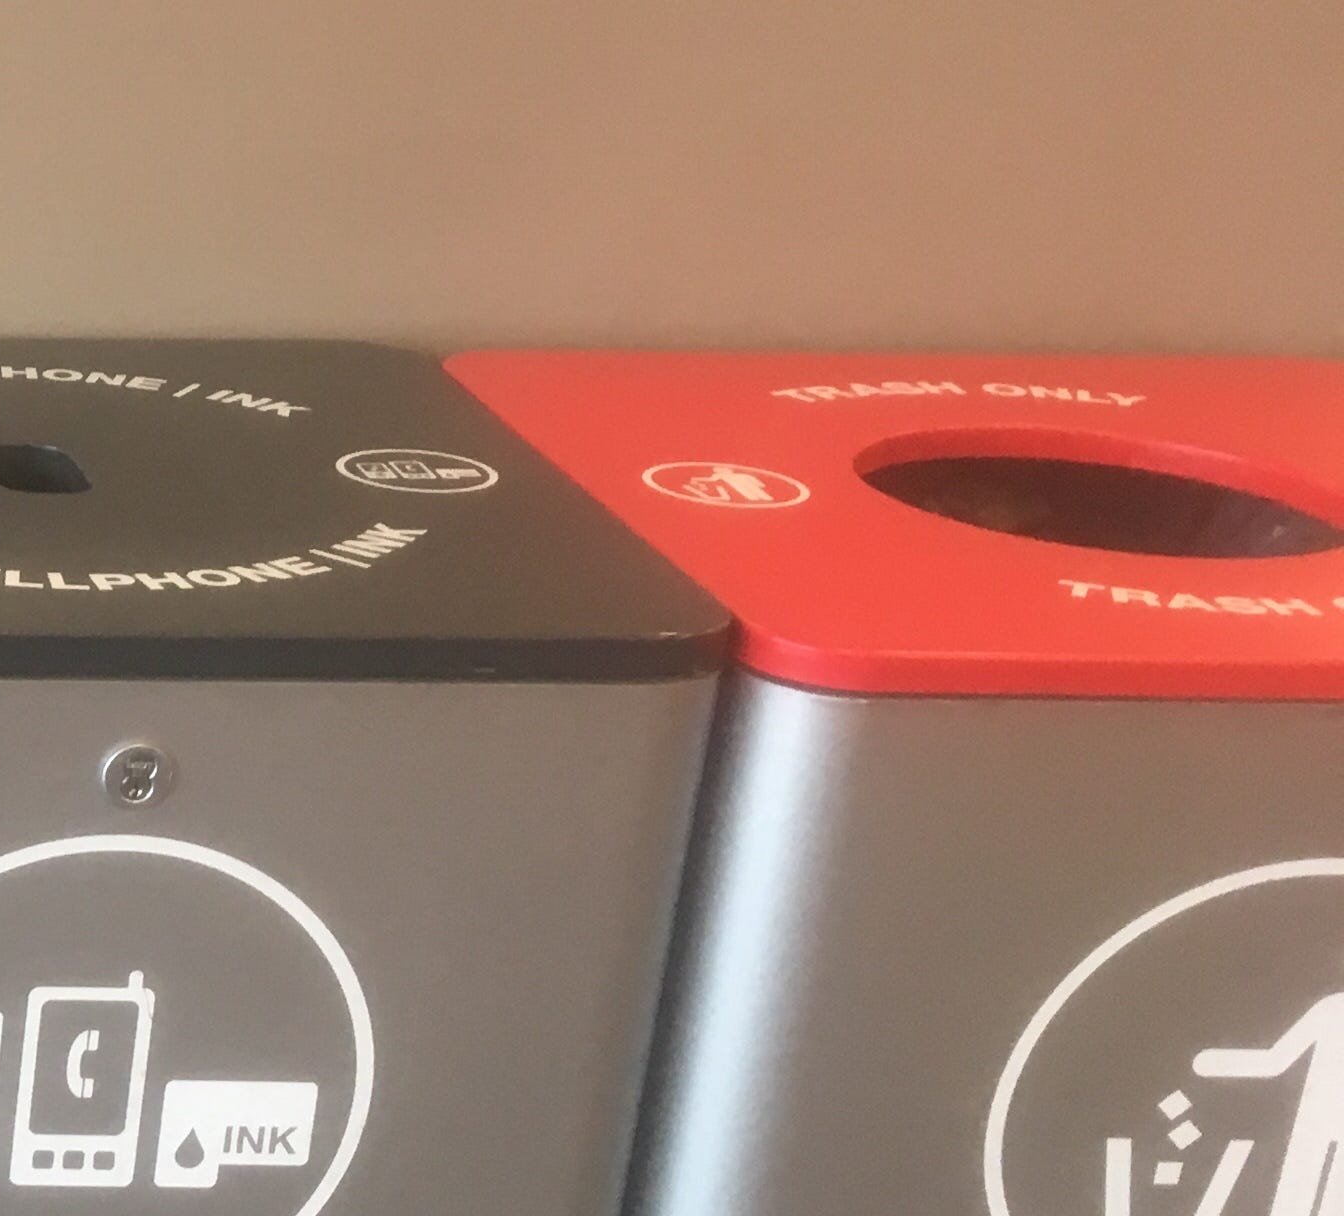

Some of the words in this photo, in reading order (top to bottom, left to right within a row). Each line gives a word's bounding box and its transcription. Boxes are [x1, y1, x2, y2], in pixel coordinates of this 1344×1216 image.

[205, 389, 311, 418] INK
[770, 381, 968, 403] TRASH
[981, 382, 1148, 407] ONLY
[330, 522, 429, 559] INK
[1057, 578, 1325, 617] TRASH
[221, 1125, 298, 1156] INK
